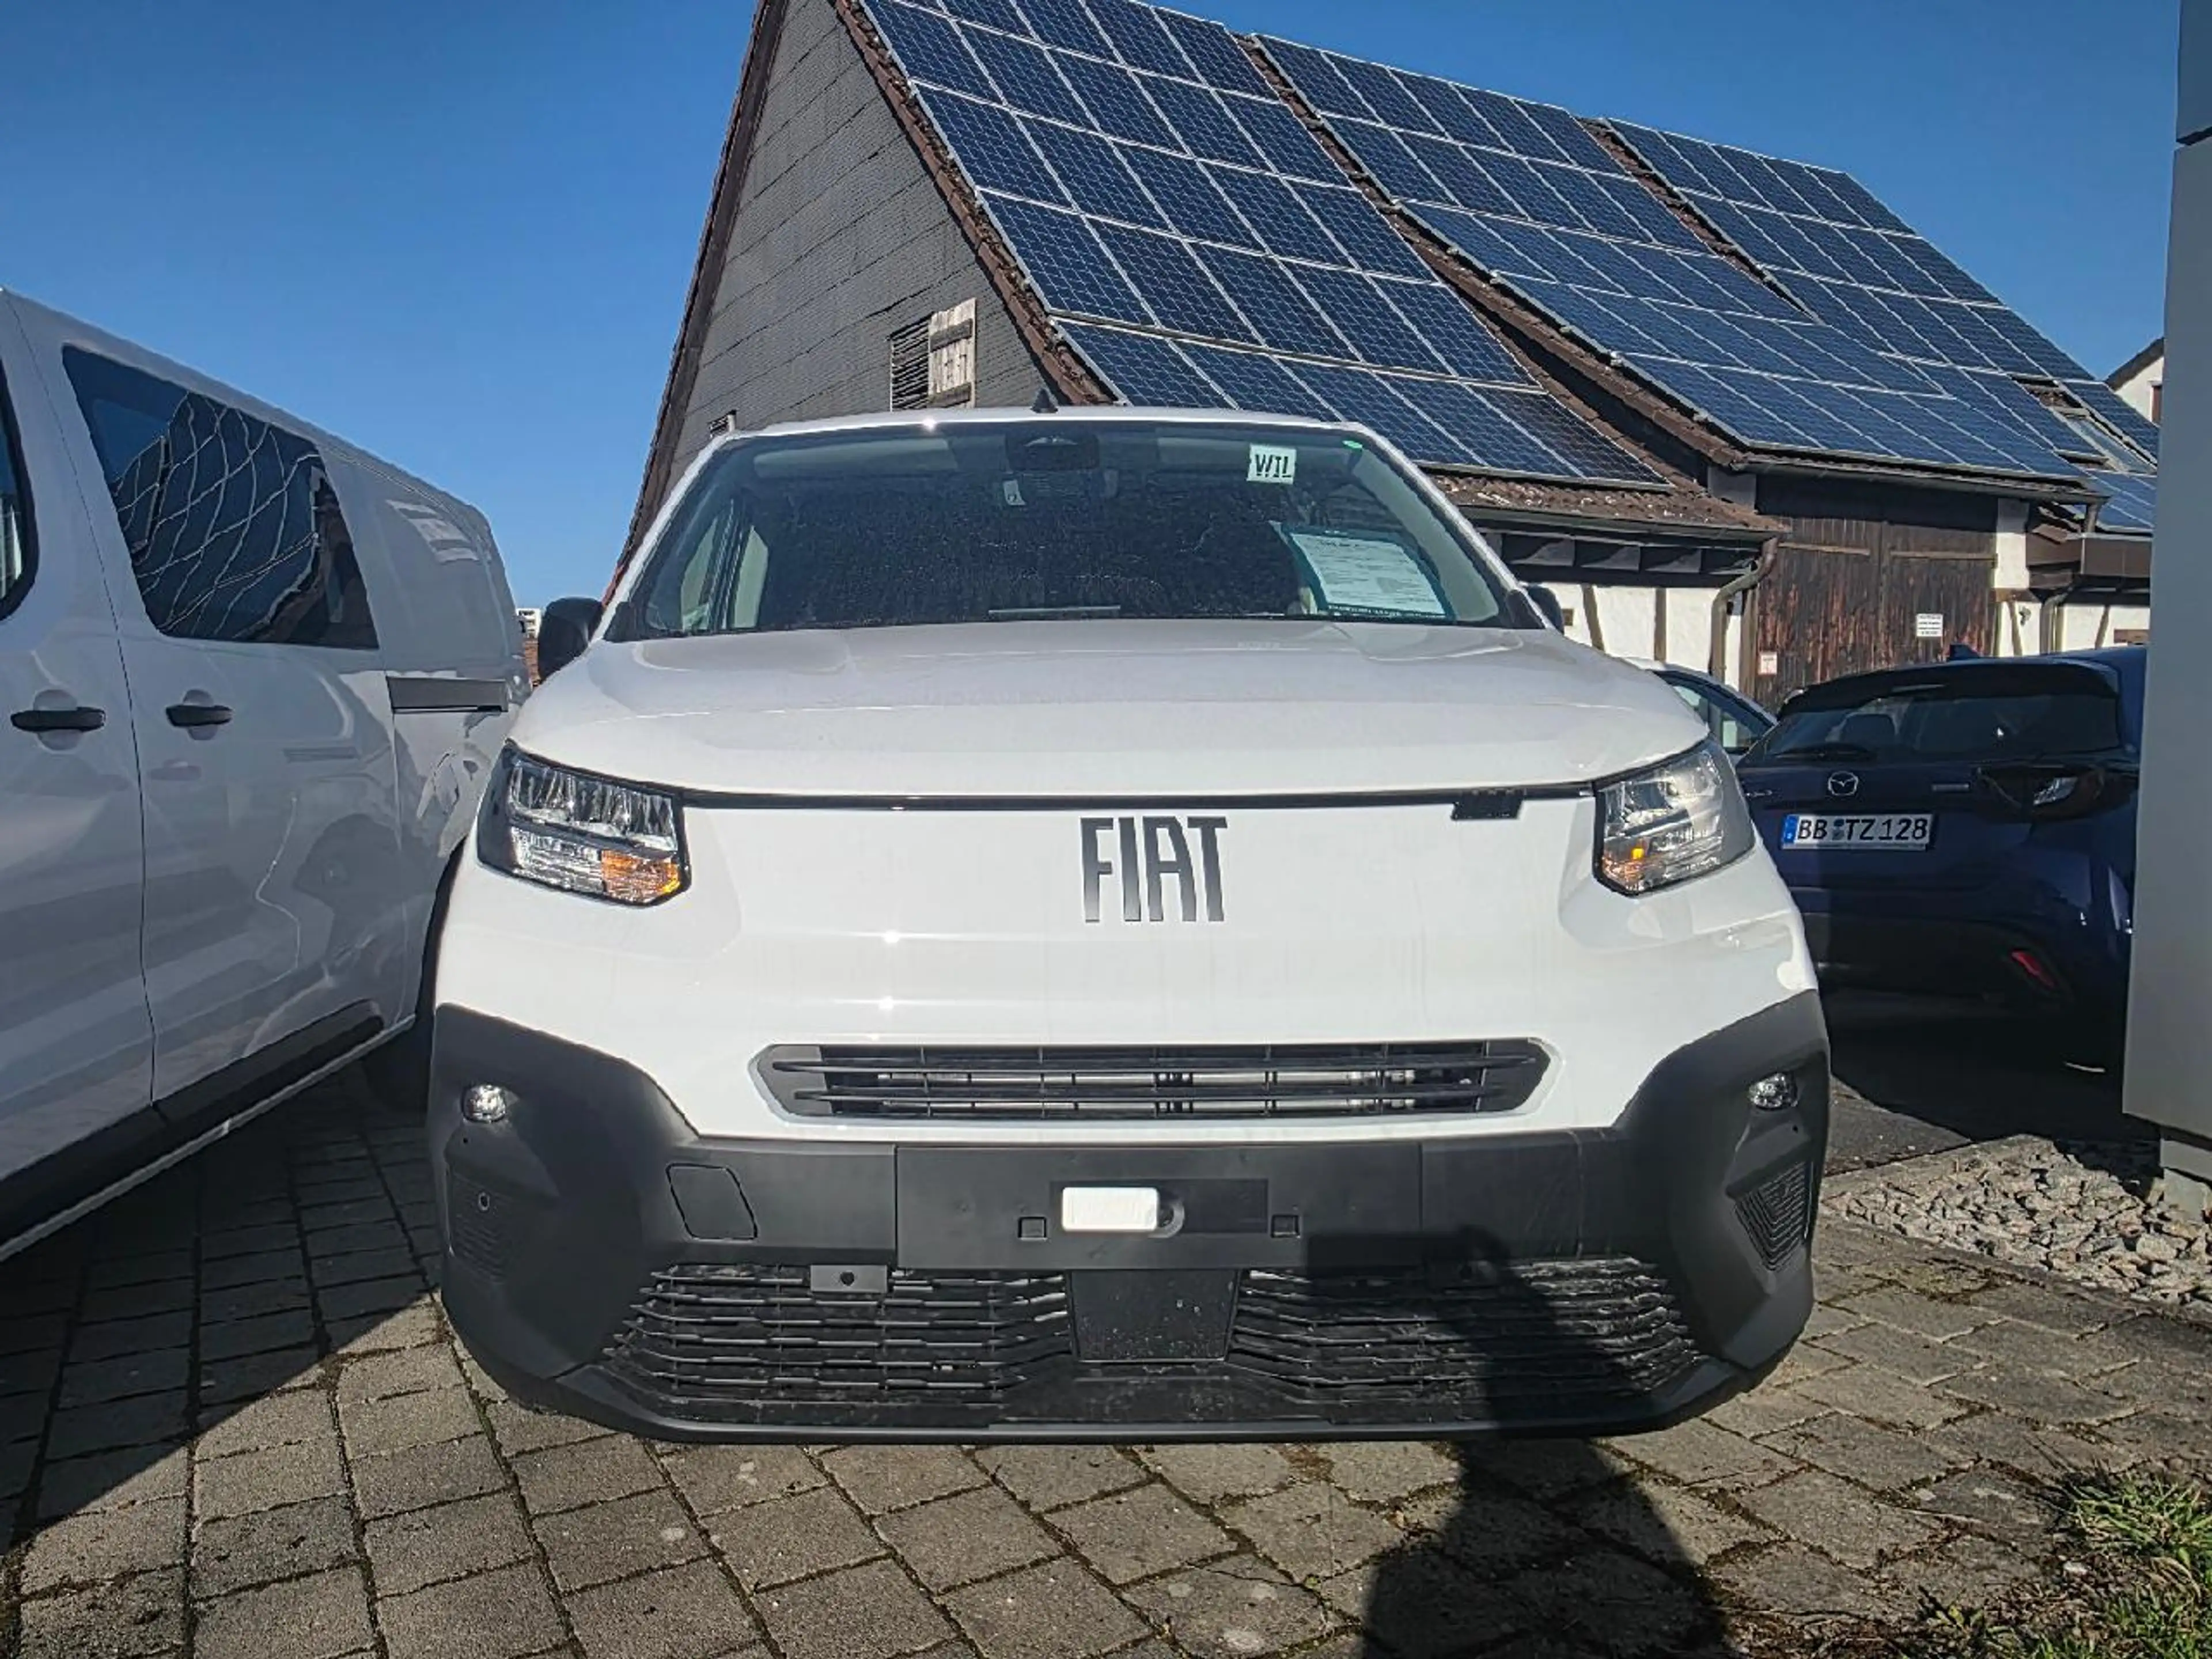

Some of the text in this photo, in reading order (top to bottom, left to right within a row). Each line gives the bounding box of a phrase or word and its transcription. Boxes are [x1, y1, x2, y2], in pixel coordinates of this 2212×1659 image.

[1797, 819, 1828, 839] BB
[1878, 819, 1928, 840] 128
[1080, 816, 1228, 922] FIAT
